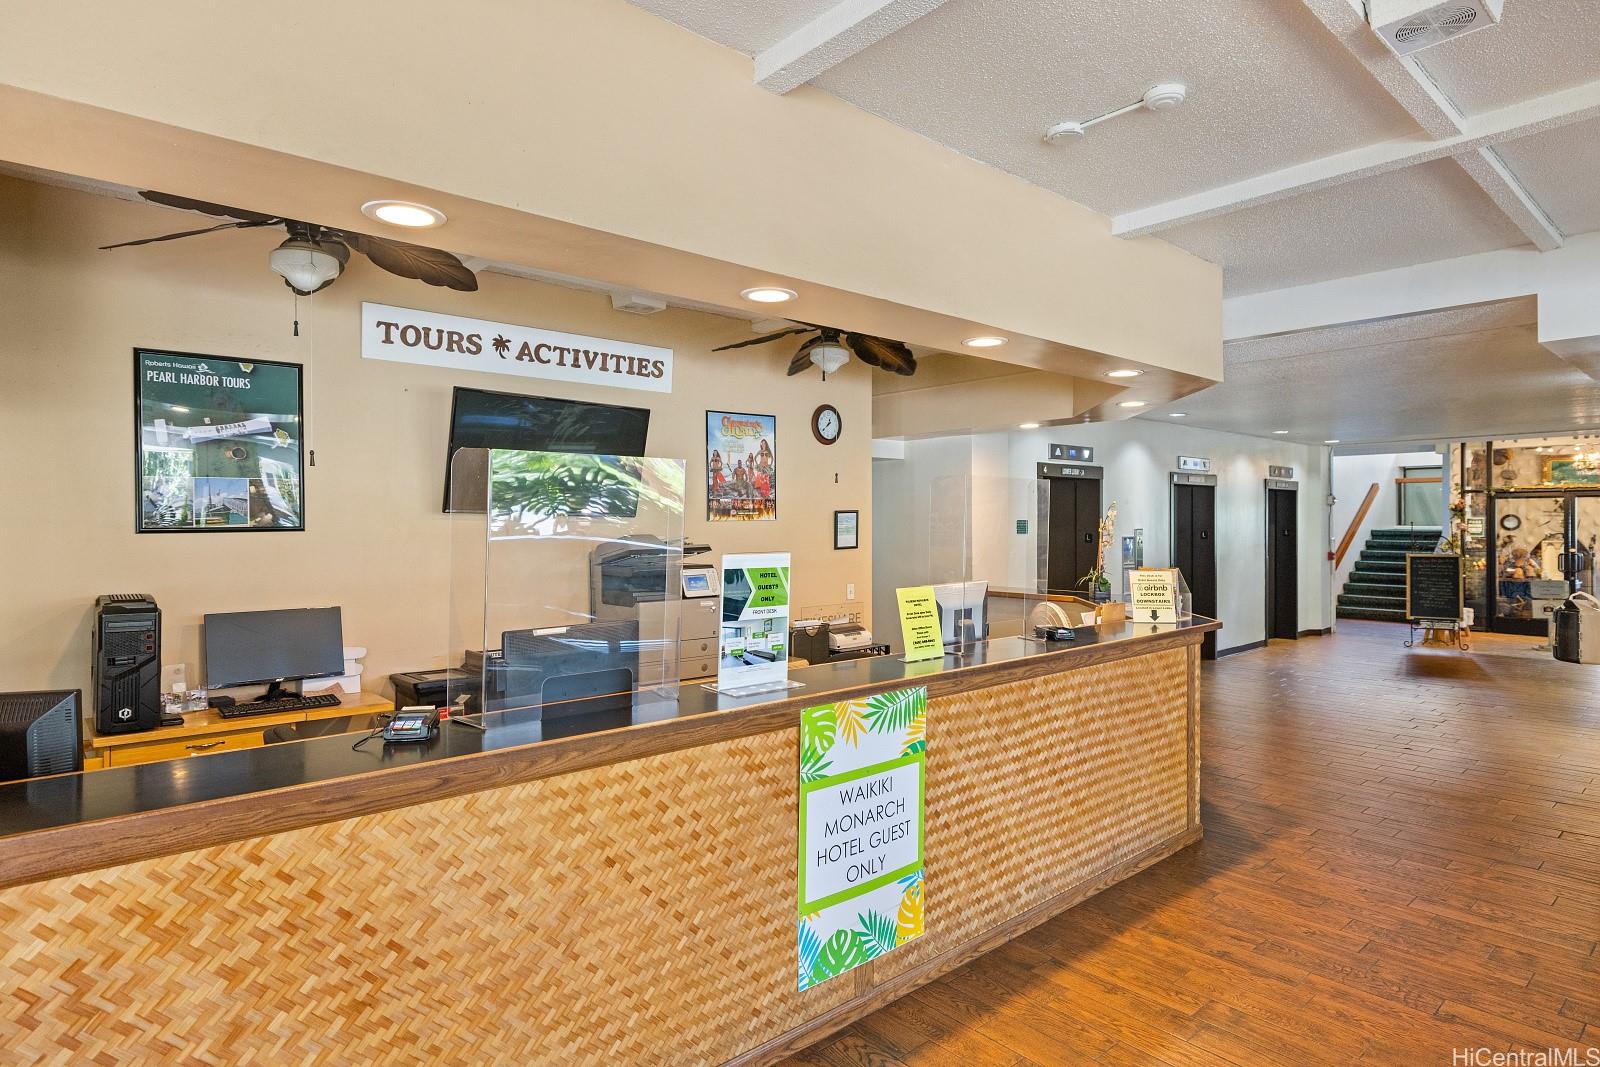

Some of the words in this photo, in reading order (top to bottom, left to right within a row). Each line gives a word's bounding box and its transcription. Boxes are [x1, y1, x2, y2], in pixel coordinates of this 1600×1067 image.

[145, 359, 172, 368] Roberts
[375, 319, 484, 356] TOURS
[515, 340, 665, 379] ACTIVITIES
[146, 370, 178, 384] PEARL
[180, 373, 220, 387] HARBOR
[222, 376, 251, 389] TOURS
[839, 775, 894, 806] WAIKIKI
[823, 797, 906, 838] MONARCH
[816, 836, 866, 868] HOTEL
[869, 819, 912, 850] GUEST
[846, 854, 888, 884] ONLY
